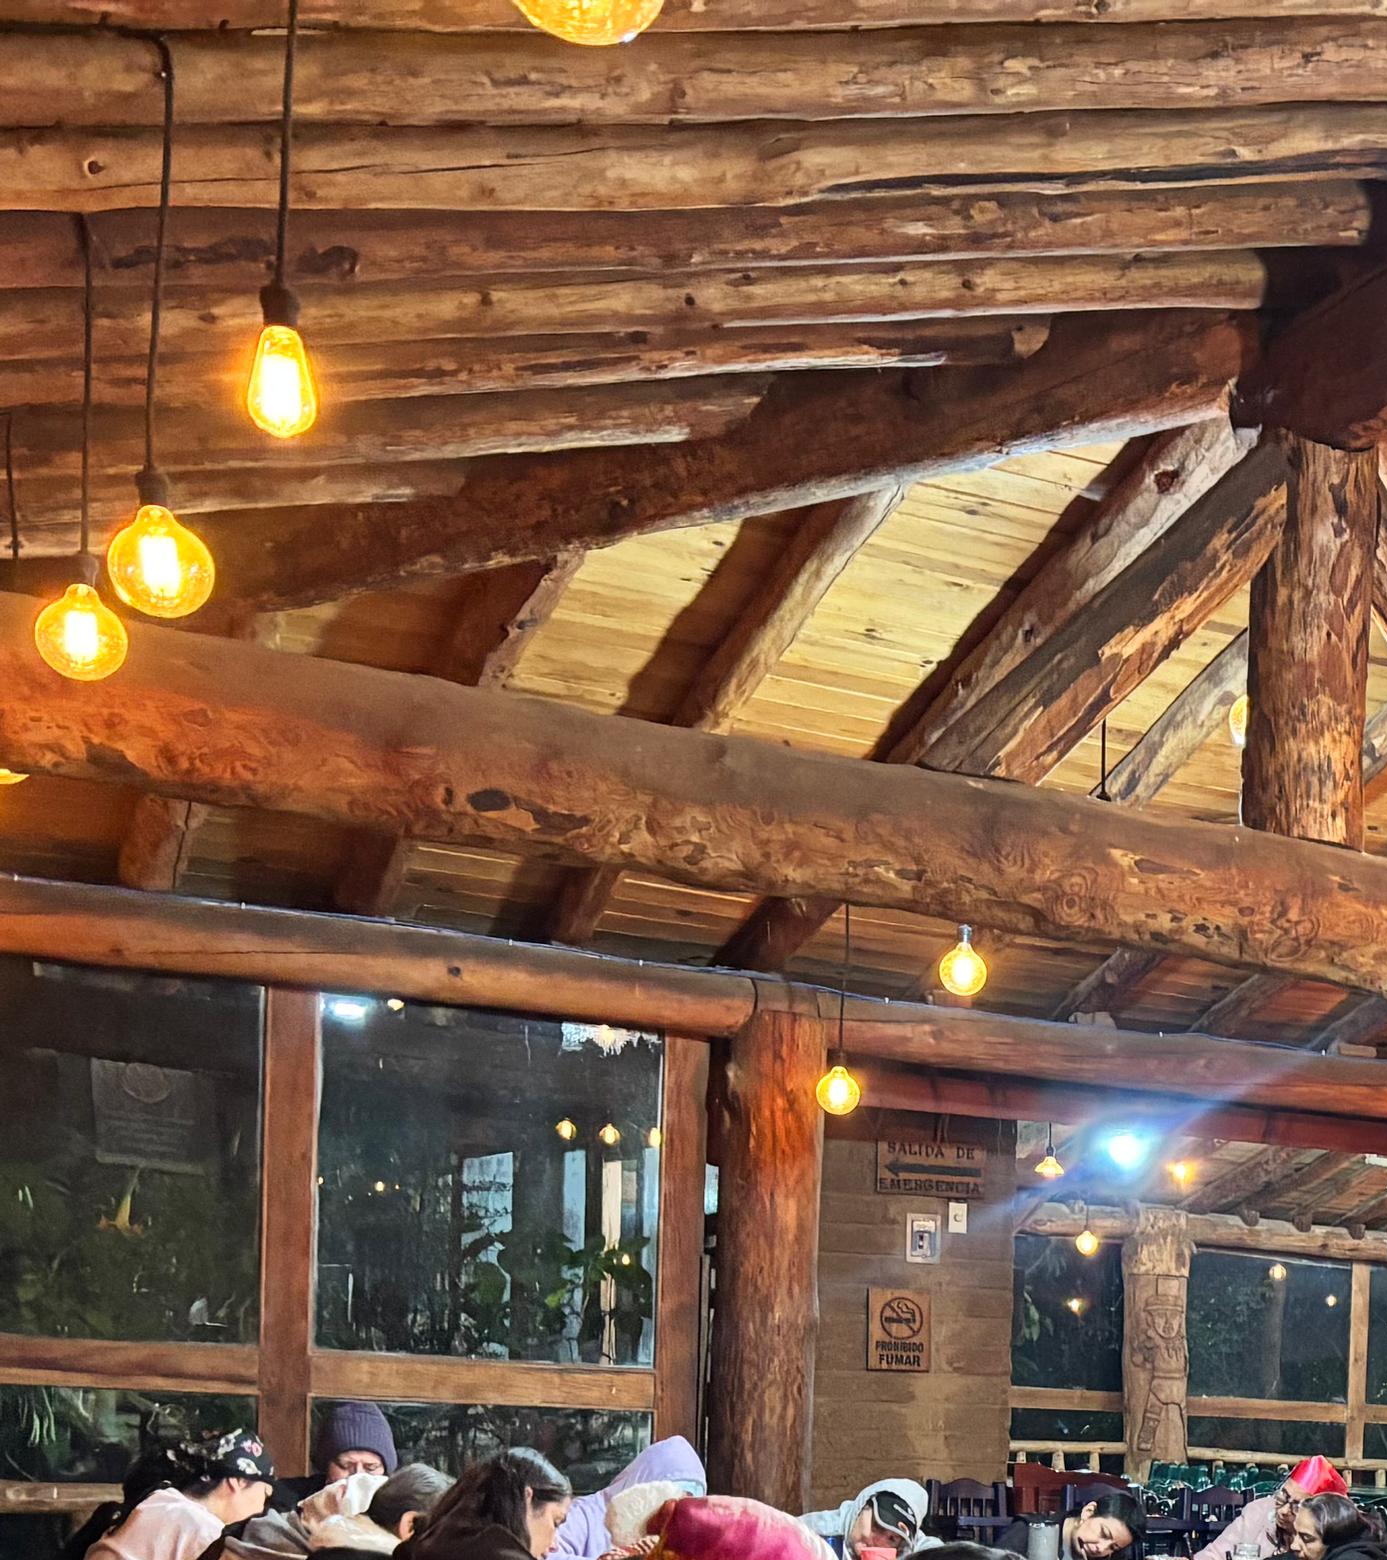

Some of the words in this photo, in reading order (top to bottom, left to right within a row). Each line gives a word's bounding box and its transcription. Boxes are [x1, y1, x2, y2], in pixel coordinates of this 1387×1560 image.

[888, 1141, 944, 1159] SALIDA
[956, 1146, 975, 1160] DE
[879, 1177, 981, 1195] EMERGENCIA
[875, 1340, 924, 1353] PROHIBIDO
[879, 1353, 921, 1367] FUMAR
